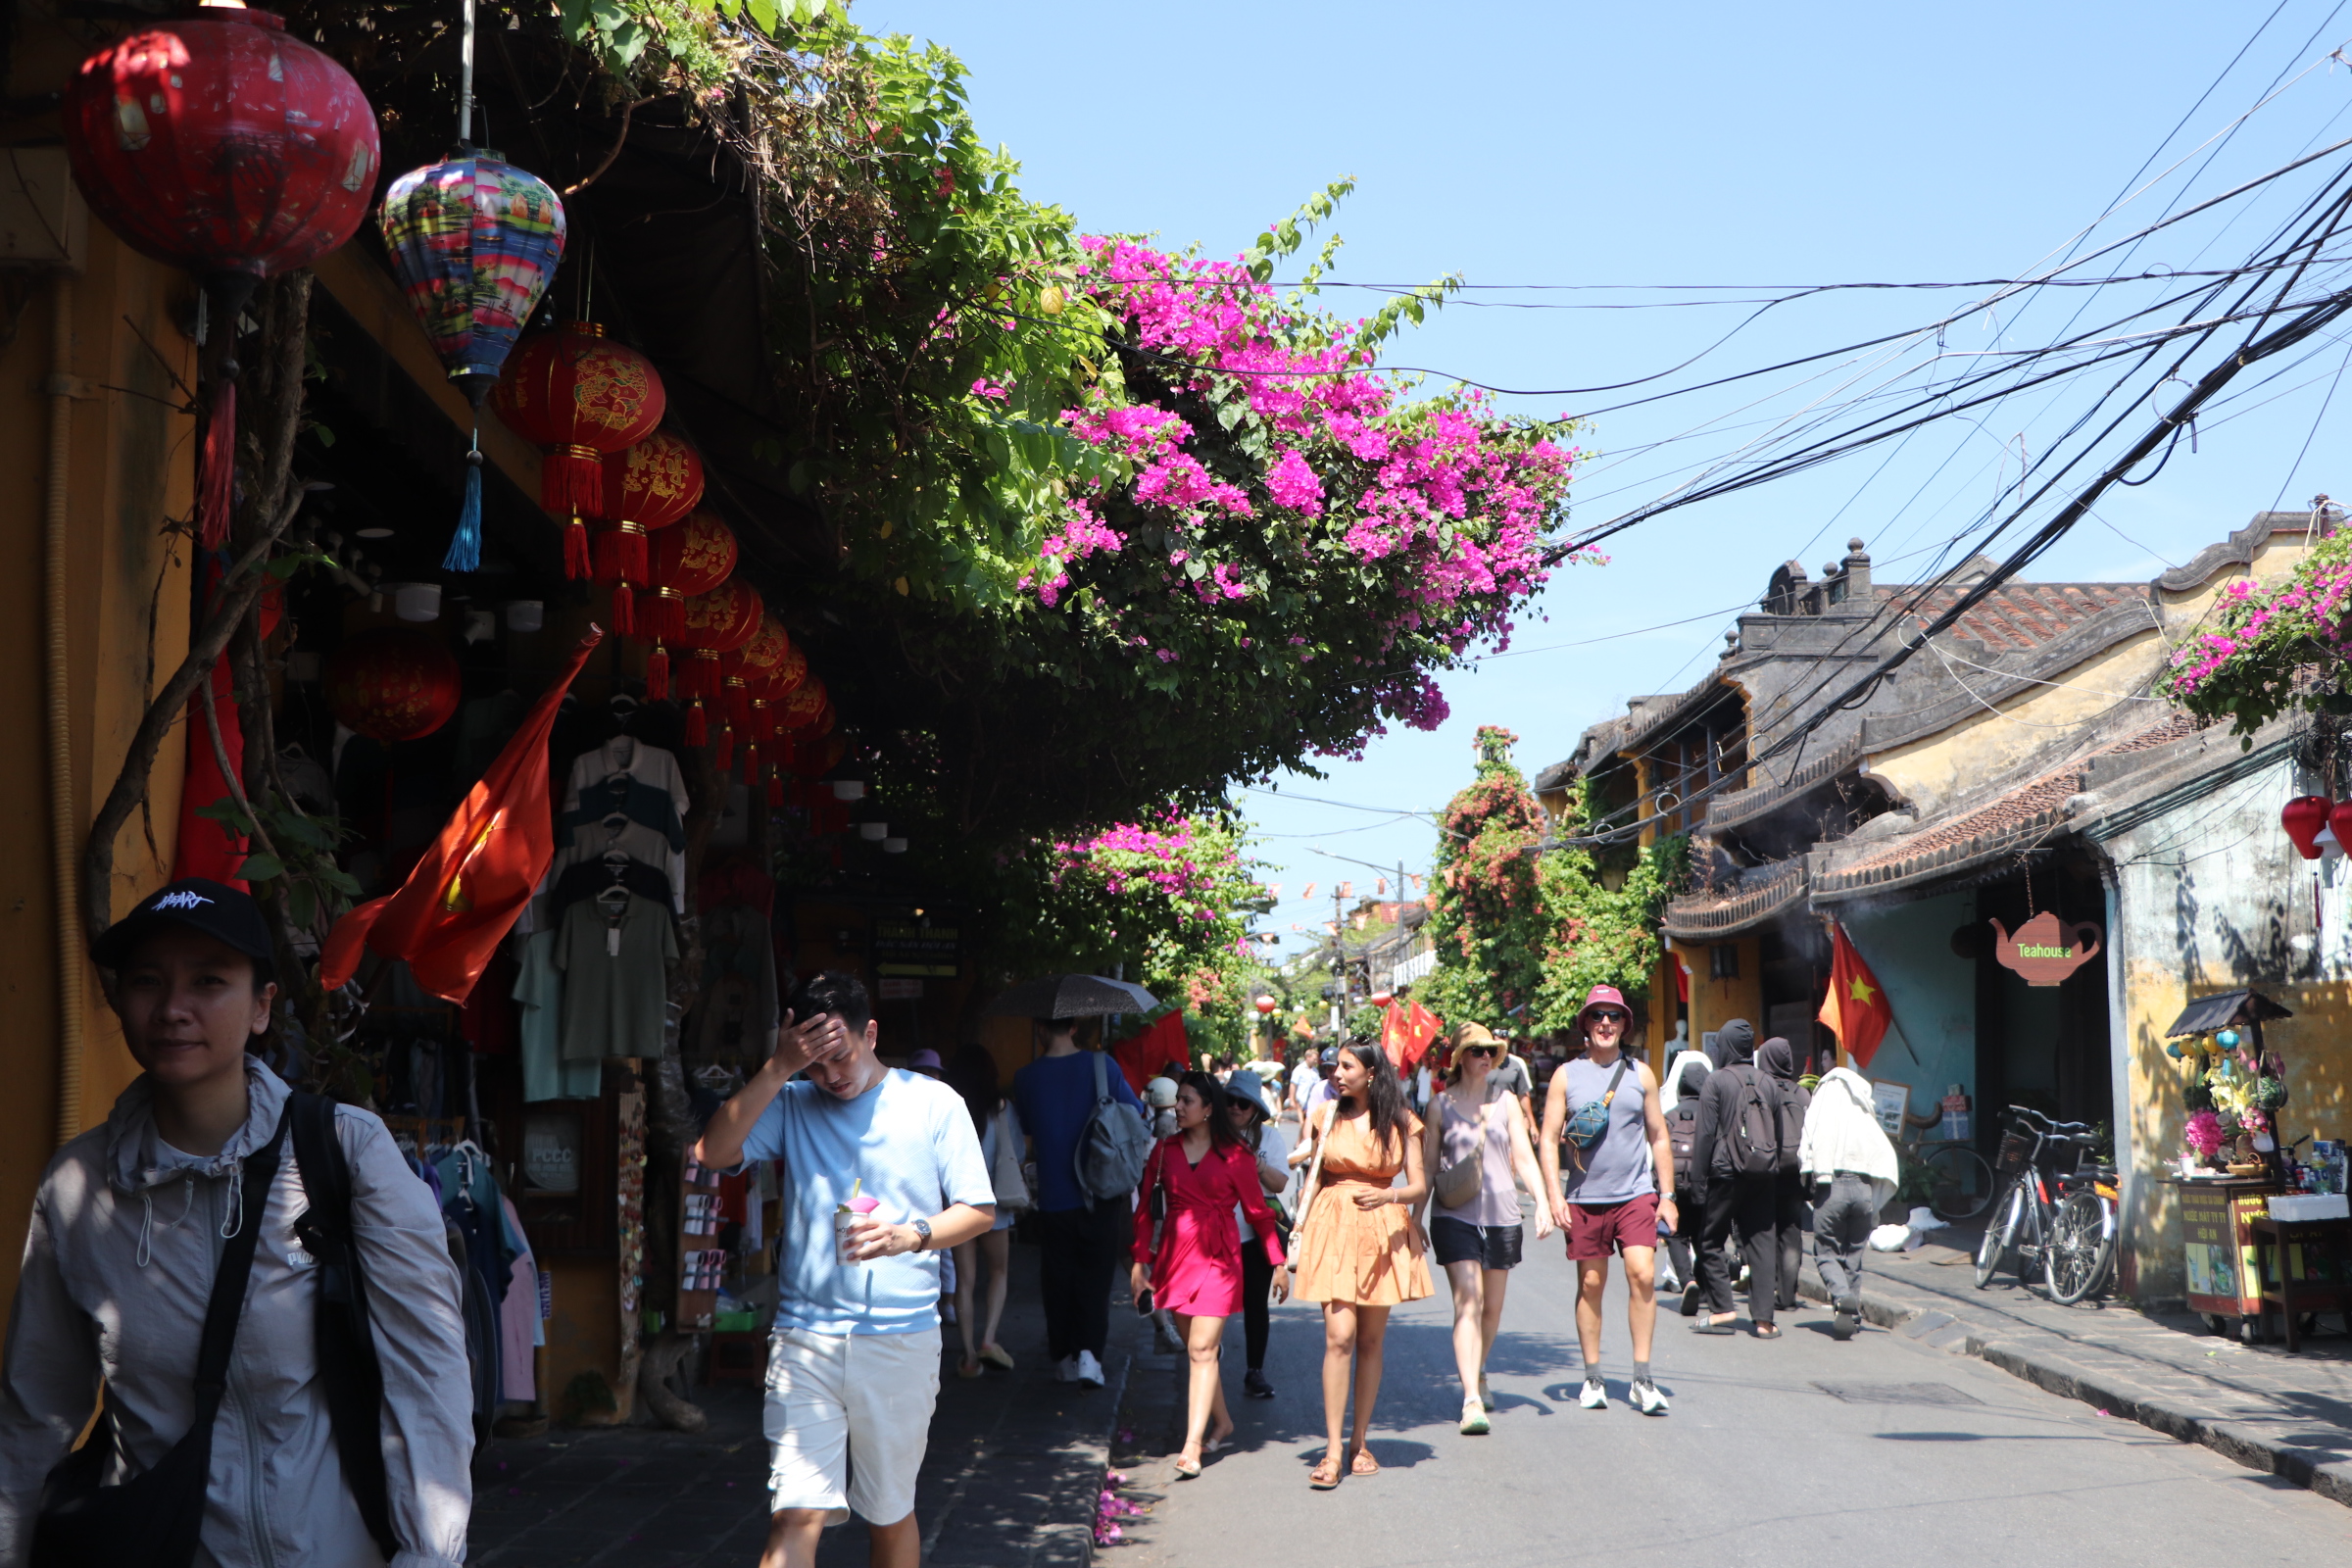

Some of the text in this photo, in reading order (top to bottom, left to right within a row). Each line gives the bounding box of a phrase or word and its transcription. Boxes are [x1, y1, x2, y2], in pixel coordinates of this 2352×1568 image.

[919, 927, 958, 940] THANH
[2017, 942, 2072, 957] Teahouse
[532, 1148, 571, 1163] PCCC
[287, 1252, 316, 1266] PUM
